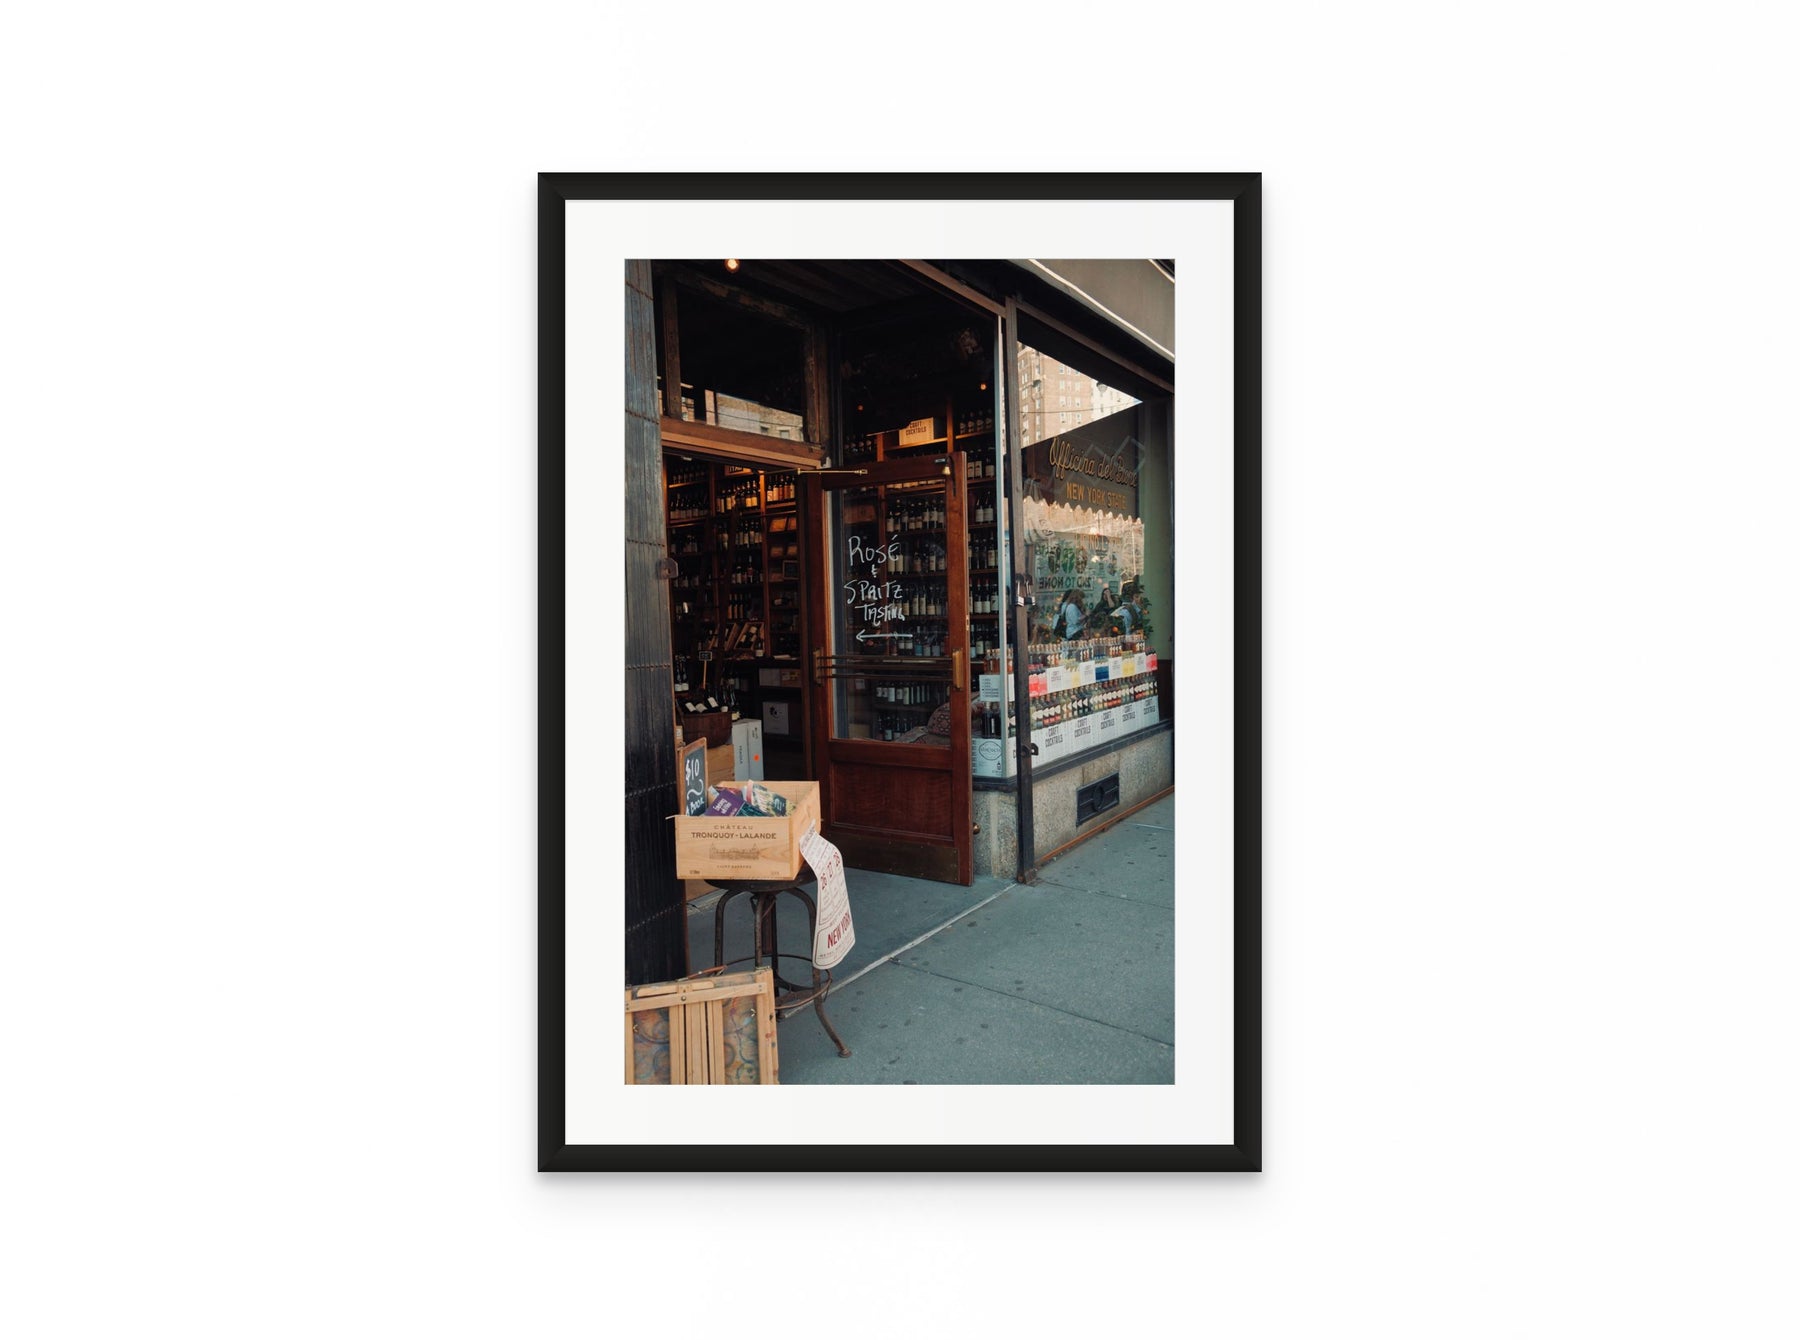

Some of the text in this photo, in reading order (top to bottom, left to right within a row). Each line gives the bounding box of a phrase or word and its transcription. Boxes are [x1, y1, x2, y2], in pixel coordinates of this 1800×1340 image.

[905, 426, 927, 436] COCKTAILS
[1049, 437, 1095, 480] Officina
[1066, 482, 1084, 501] NEW
[1087, 486, 1106, 506] YORK
[1124, 704, 1133, 714] CRAFT
[1102, 711, 1112, 721] CRAFT
[1122, 711, 1136, 722] COCKTAILS
[1077, 718, 1088, 728] CRAFT
[1100, 718, 1115, 730] COCKTAILS
[1048, 726, 1059, 737] CRAFT
[1074, 725, 1091, 738] COCKTAILS
[1045, 734, 1063, 748] COCKTAILS
[685, 758, 700, 785] $10
[827, 928, 840, 949] NEW
